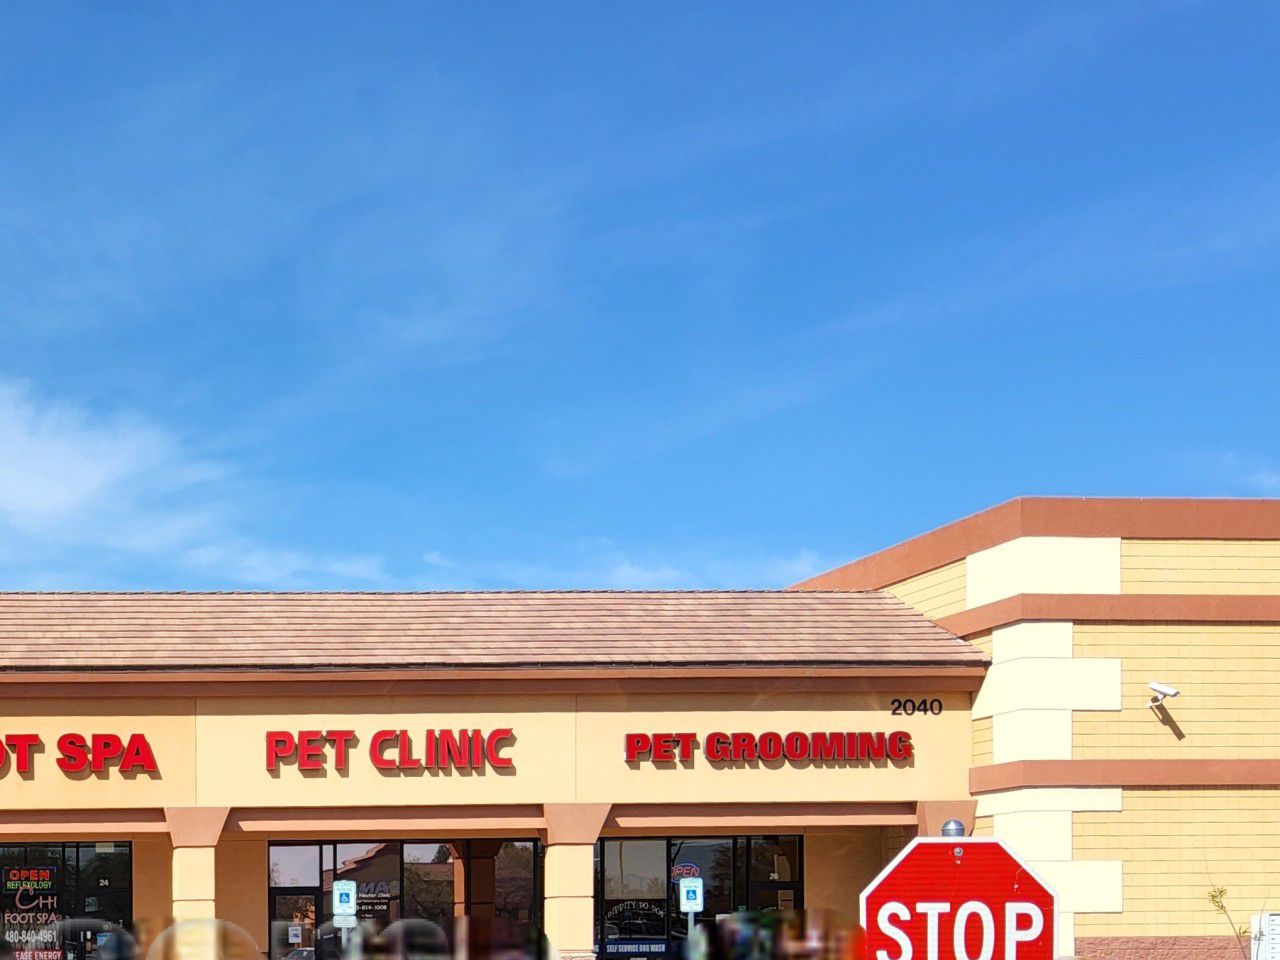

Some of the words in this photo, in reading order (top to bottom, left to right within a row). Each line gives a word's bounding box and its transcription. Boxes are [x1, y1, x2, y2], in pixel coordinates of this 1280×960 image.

[891, 699, 943, 716] 2040
[266, 730, 355, 769] PET
[369, 728, 513, 768] CLINIC
[624, 732, 697, 761] PET
[704, 731, 914, 761] GROOMING
[56, 733, 157, 772] SPA
[9, 869, 51, 880] OPEN
[6, 881, 52, 889] REFLEXOLOGY
[99, 879, 109, 887] 24
[4, 912, 36, 923] FOOT
[36, 912, 58, 923] SPA
[4, 930, 57, 942] 480-840-4961
[14, 951, 32, 960] EASE
[34, 951, 62, 960] ENERGY
